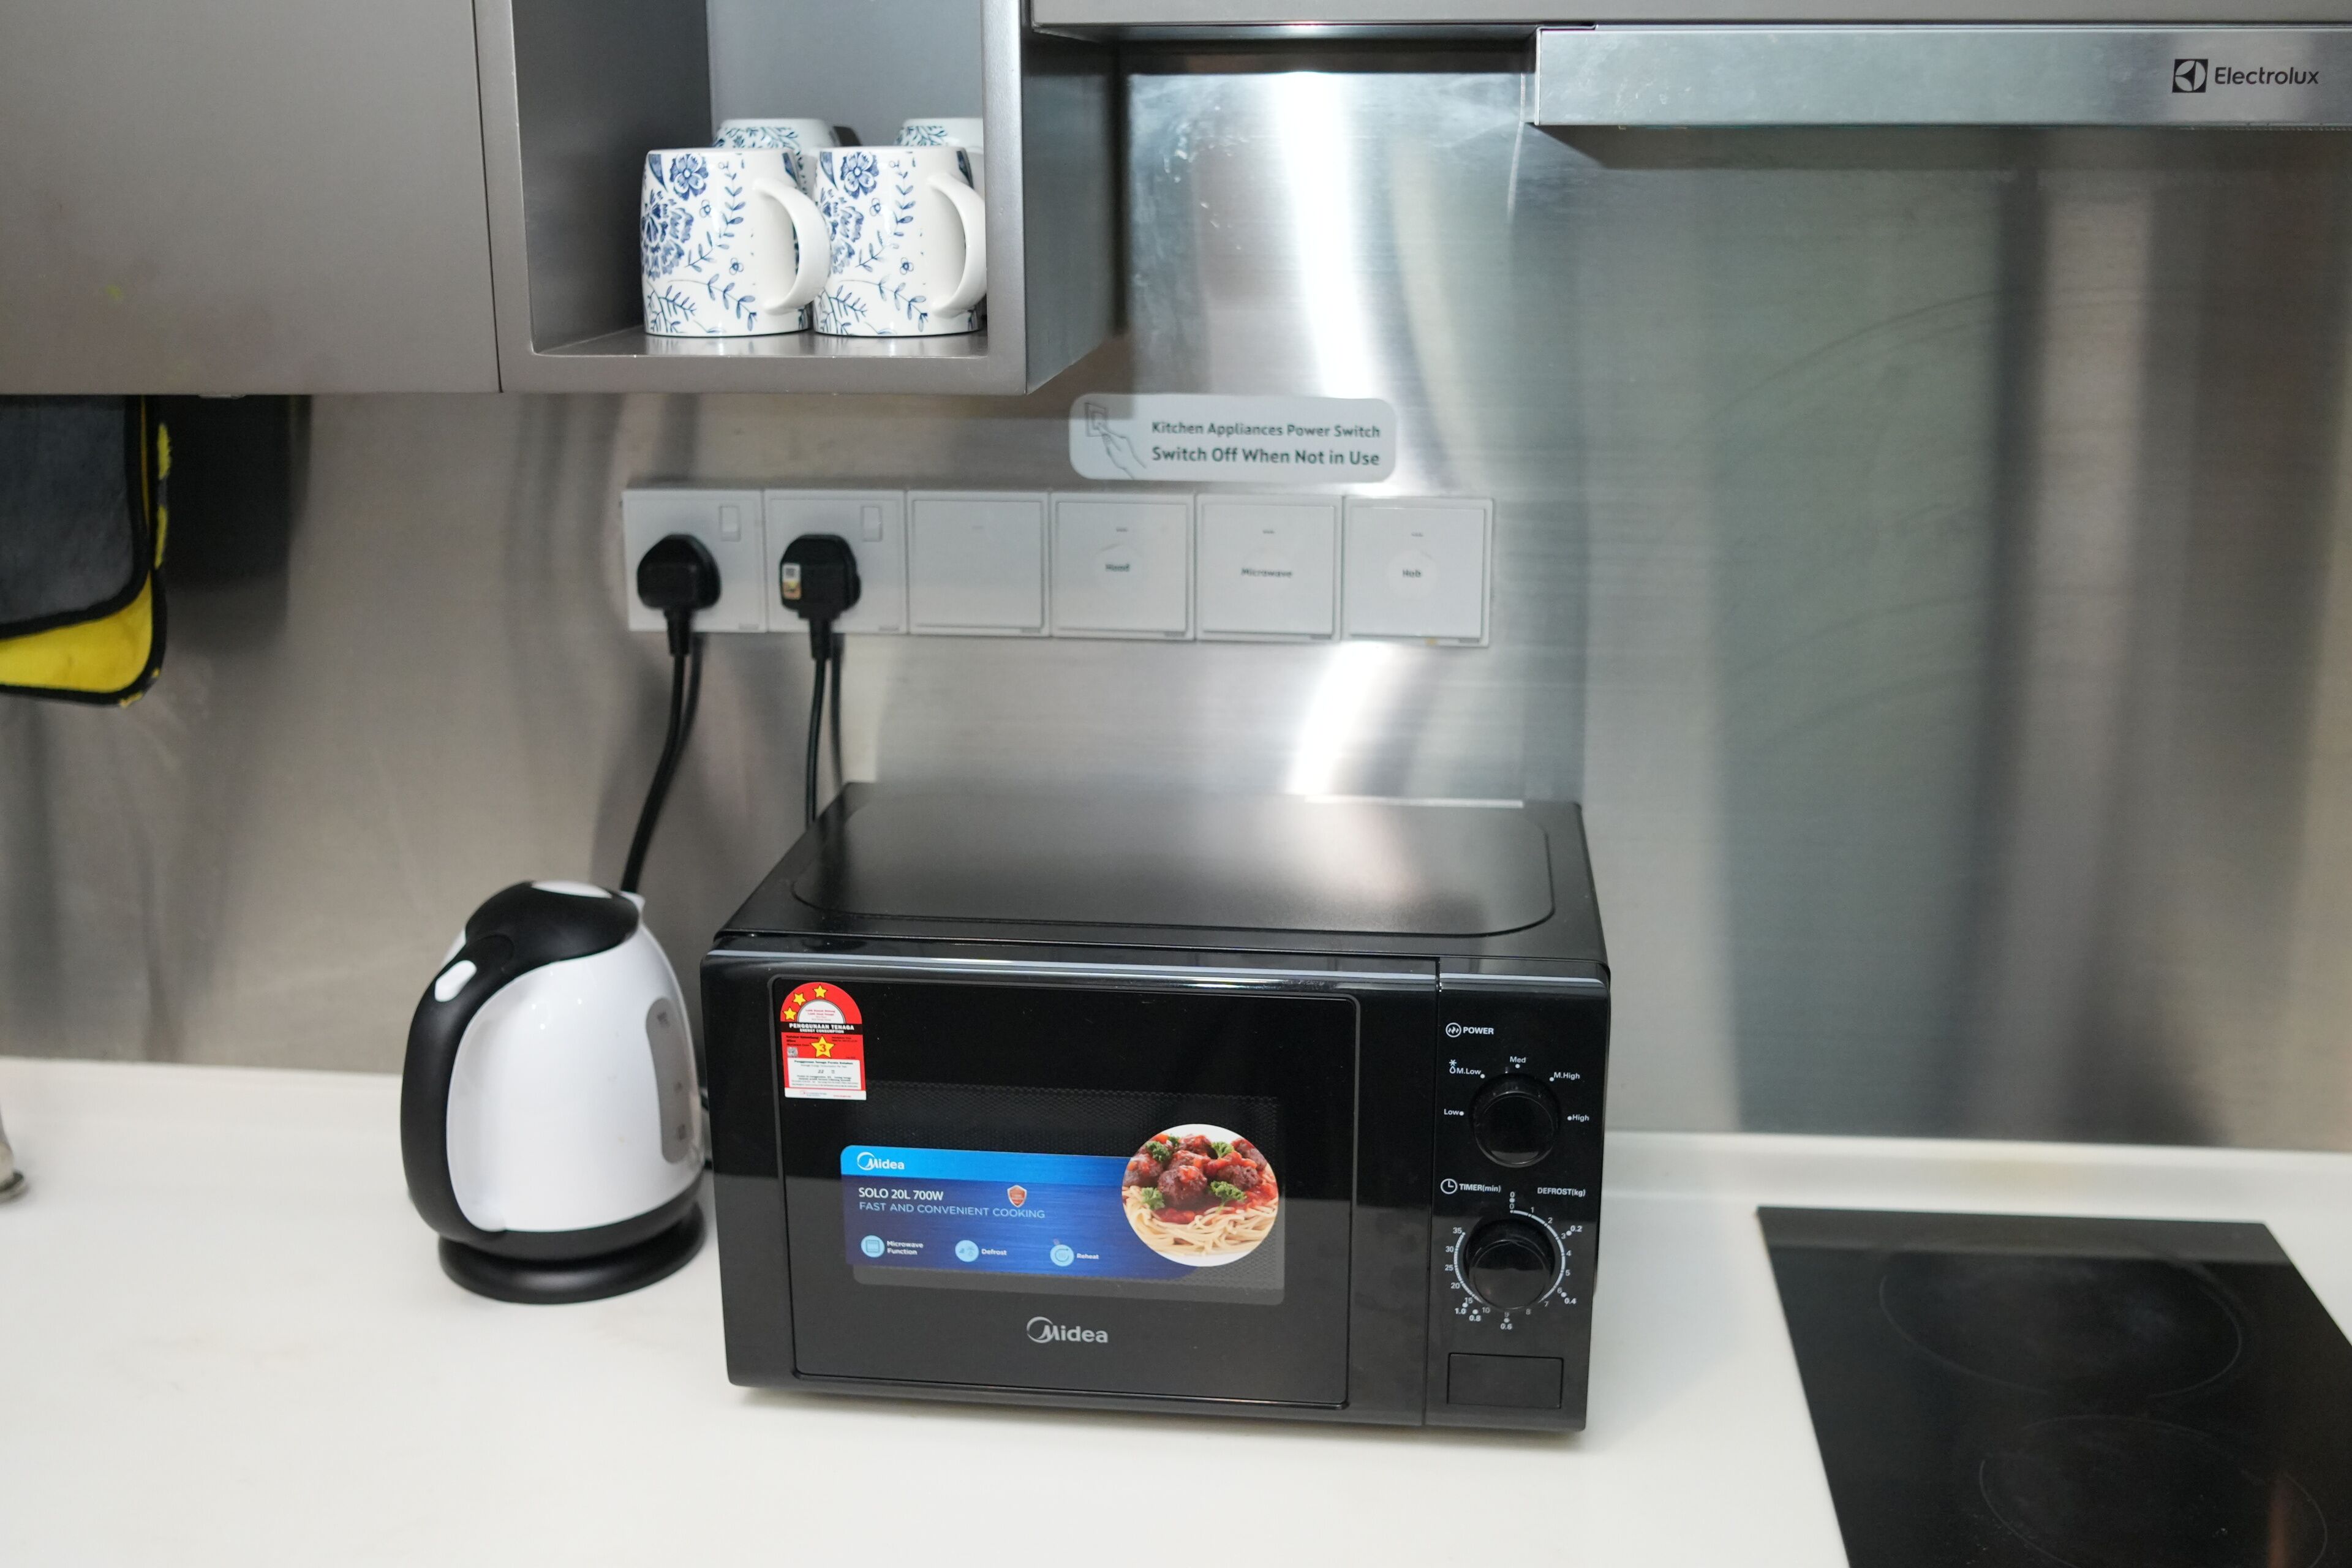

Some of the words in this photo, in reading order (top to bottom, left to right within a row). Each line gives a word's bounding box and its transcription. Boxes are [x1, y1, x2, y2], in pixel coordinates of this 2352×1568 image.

[2214, 67, 2320, 85] Electrolux
[1152, 421, 1204, 435] Kitchen
[1207, 423, 1283, 438] Appliances
[1287, 424, 1330, 437] Power
[1333, 425, 1380, 438] Switch
[1152, 447, 1207, 462] Switch
[1212, 447, 1238, 462] Off
[1242, 448, 1289, 464] When
[1295, 450, 1325, 464] Not
[1329, 451, 1344, 464] in
[1349, 452, 1380, 466] Use
[1241, 567, 1293, 579] Microwave
[1403, 568, 1422, 578] Hob
[1463, 1027, 1494, 1035] POWER
[819, 1044, 826, 1052] 3
[857, 1152, 905, 1170] Midea
[859, 1187, 889, 1199] SOLO
[891, 1189, 911, 1200] 20L
[913, 1190, 944, 1201] 700W
[1459, 1183, 1501, 1193] TIMER(min)
[1537, 1187, 1586, 1197] DEFROST(kg)
[859, 1201, 886, 1211] FAST
[890, 1203, 914, 1213] AND
[918, 1204, 990, 1216] CONVENIENT
[992, 1208, 1046, 1218] COOKING
[1026, 1316, 1109, 1343] Midea
